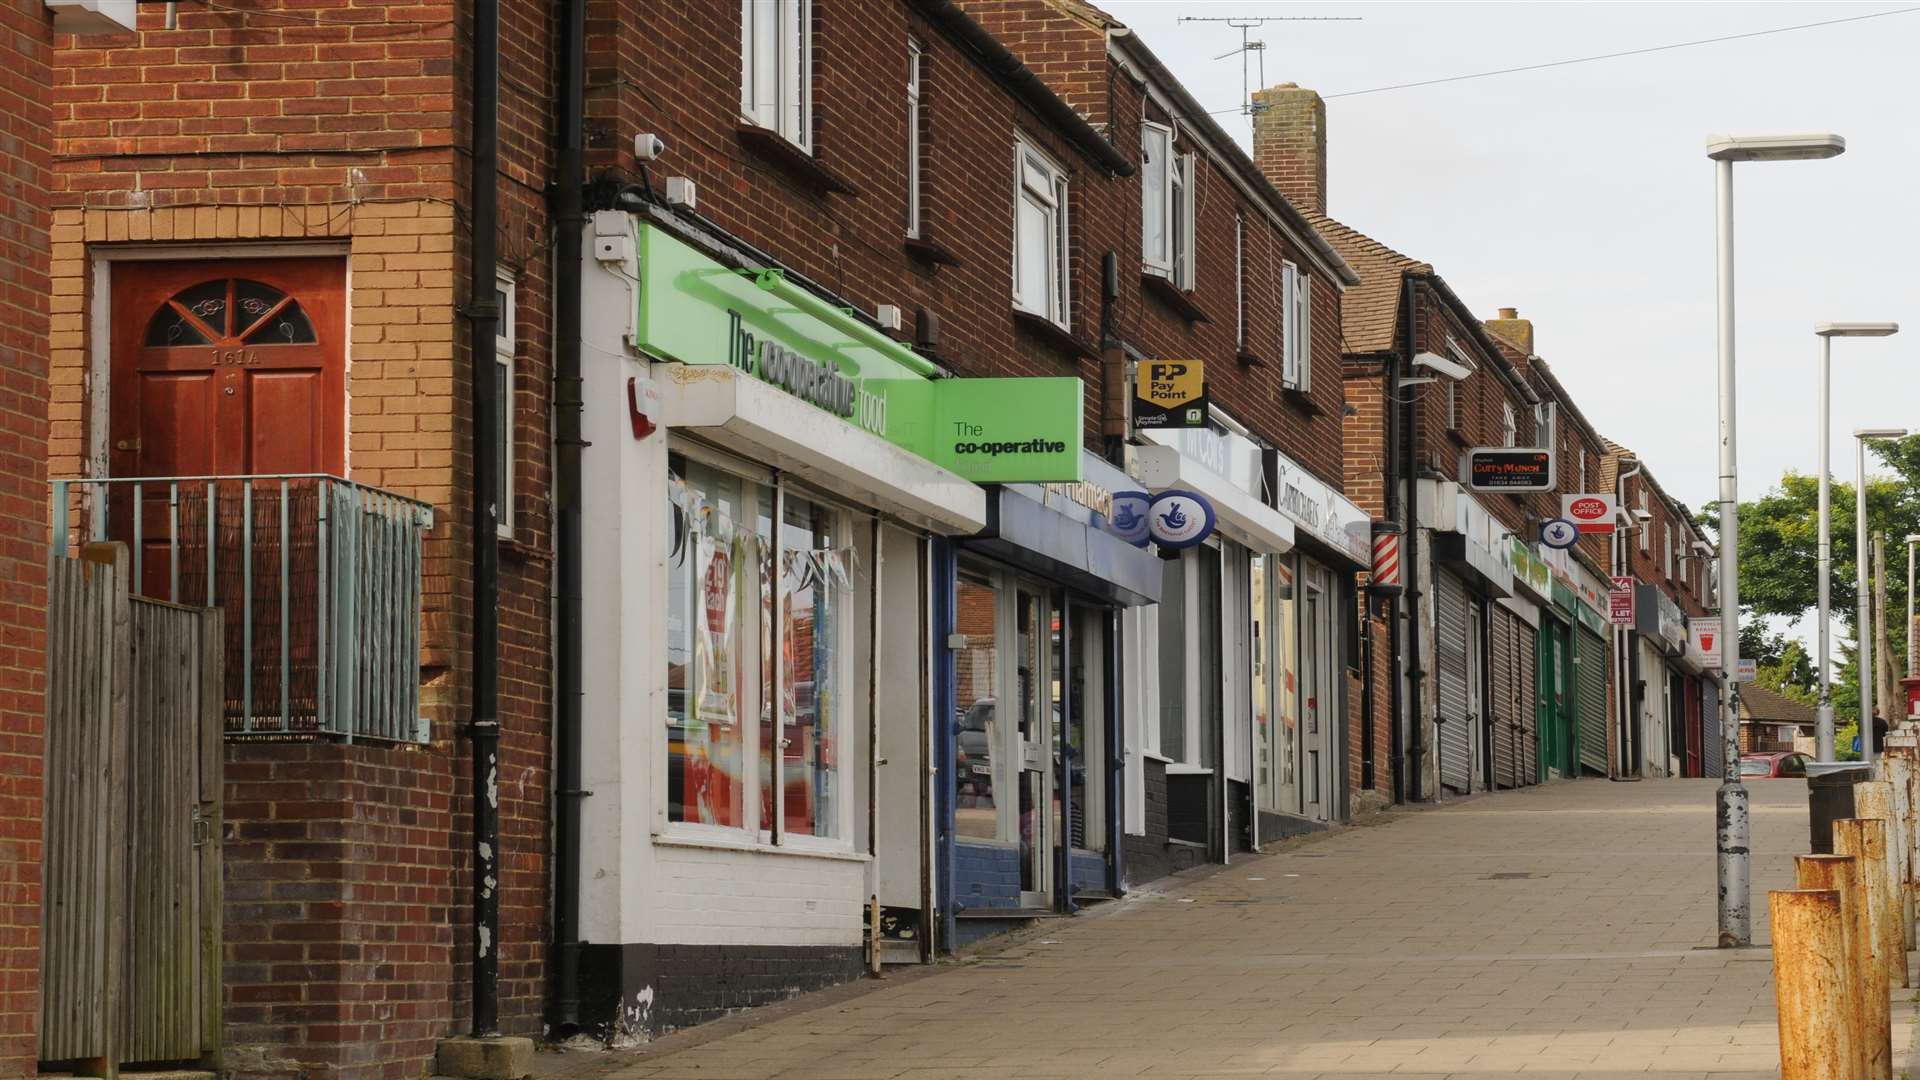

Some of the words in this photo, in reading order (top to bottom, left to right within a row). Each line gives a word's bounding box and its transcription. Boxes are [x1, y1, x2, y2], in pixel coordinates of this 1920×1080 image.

[211, 350, 261, 366] 161A
[728, 308, 755, 374] The
[859, 376, 887, 437] food
[1151, 382, 1175, 391] Pay
[1151, 391, 1187, 399] Point
[953, 421, 983, 437] The
[954, 439, 1066, 457] co-operative
